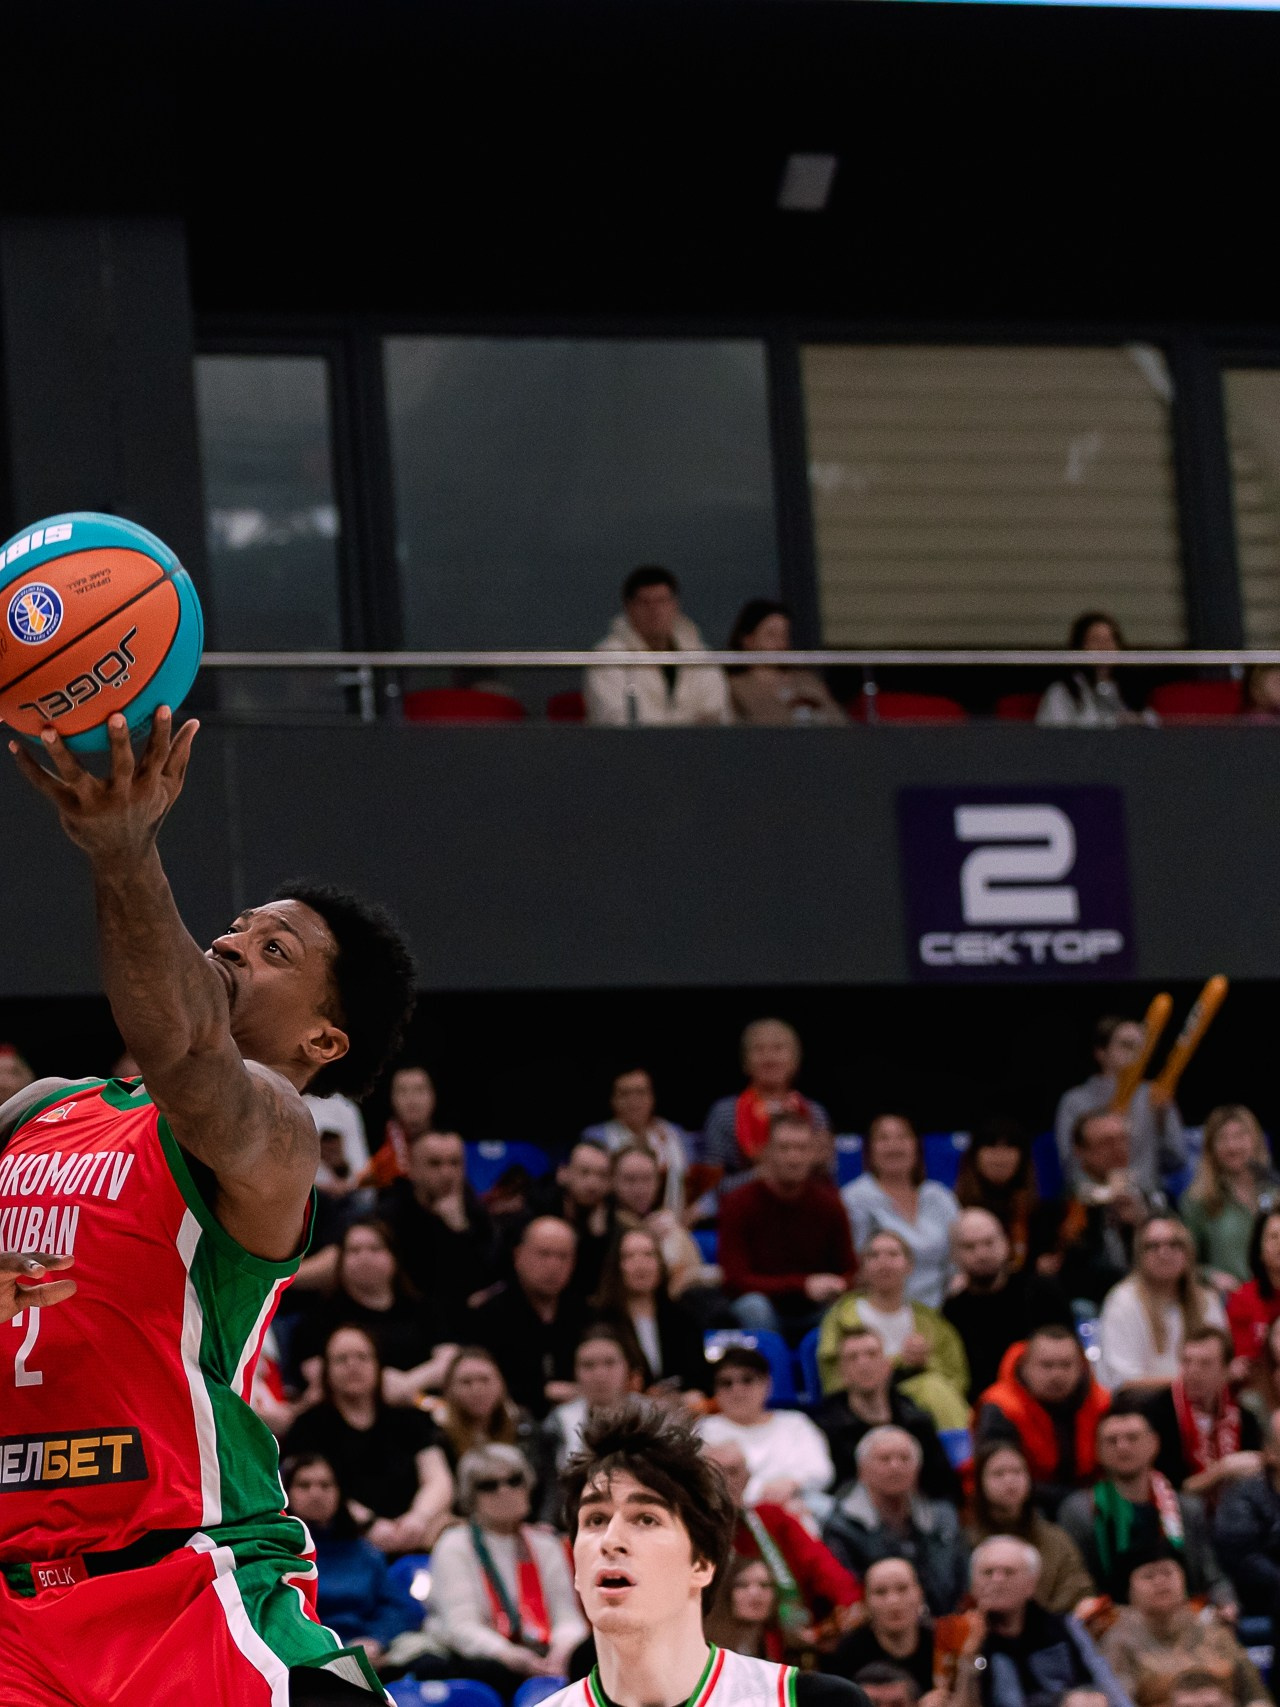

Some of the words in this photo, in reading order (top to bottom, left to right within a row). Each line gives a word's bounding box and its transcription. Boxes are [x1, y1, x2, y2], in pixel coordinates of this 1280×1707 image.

[18, 625, 138, 721] JÖGEL
[954, 804, 1079, 926] 2
[920, 930, 1124, 967] СЕКТОР
[11, 1306, 43, 1388] 2
[38, 1567, 76, 1588] BCLK
